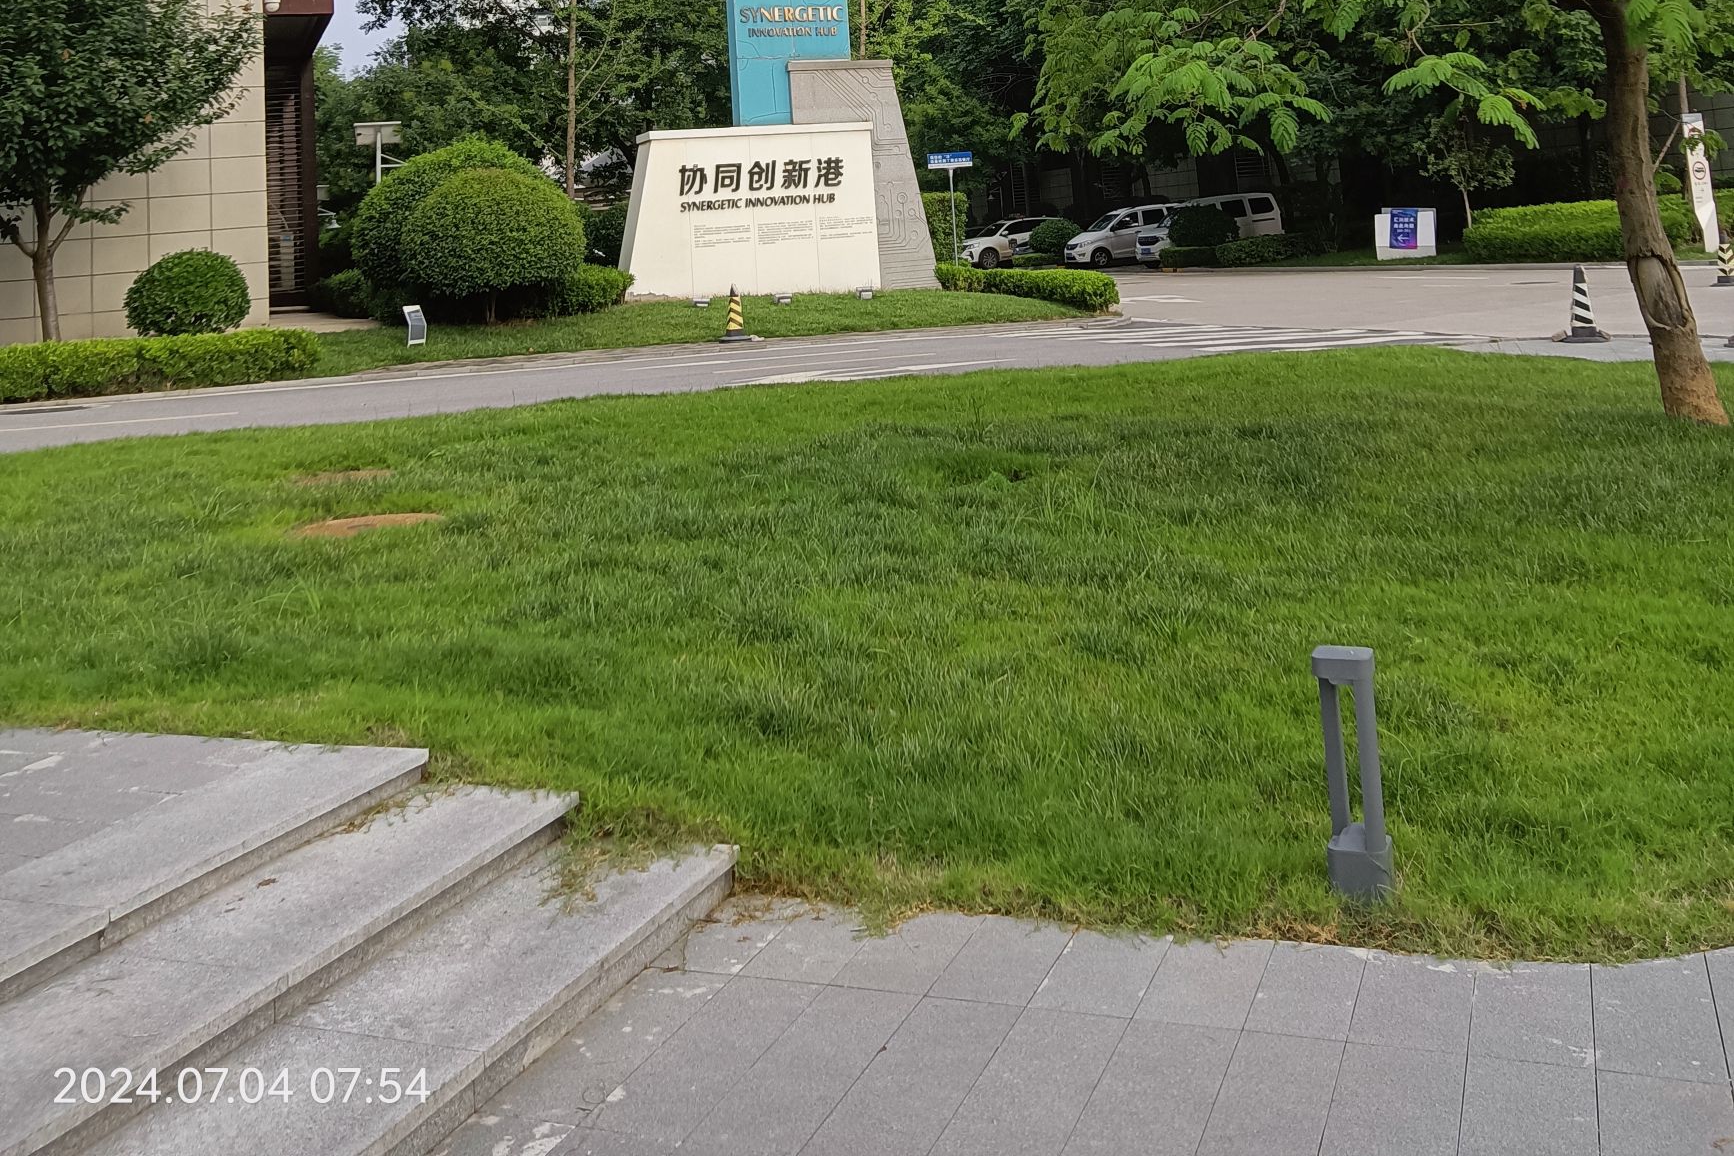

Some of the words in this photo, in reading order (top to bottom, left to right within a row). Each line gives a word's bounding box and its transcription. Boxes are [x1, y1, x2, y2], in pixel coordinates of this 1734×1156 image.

[740, 5, 844, 23] SYNERGETIC
[748, 27, 812, 38] INNOVATION
[815, 26, 838, 37] HUB
[679, 157, 844, 196] 协同创新港
[680, 198, 742, 213] SYNERGETIC
[744, 194, 810, 209] INNOVATION
[812, 193, 836, 205] HUB
